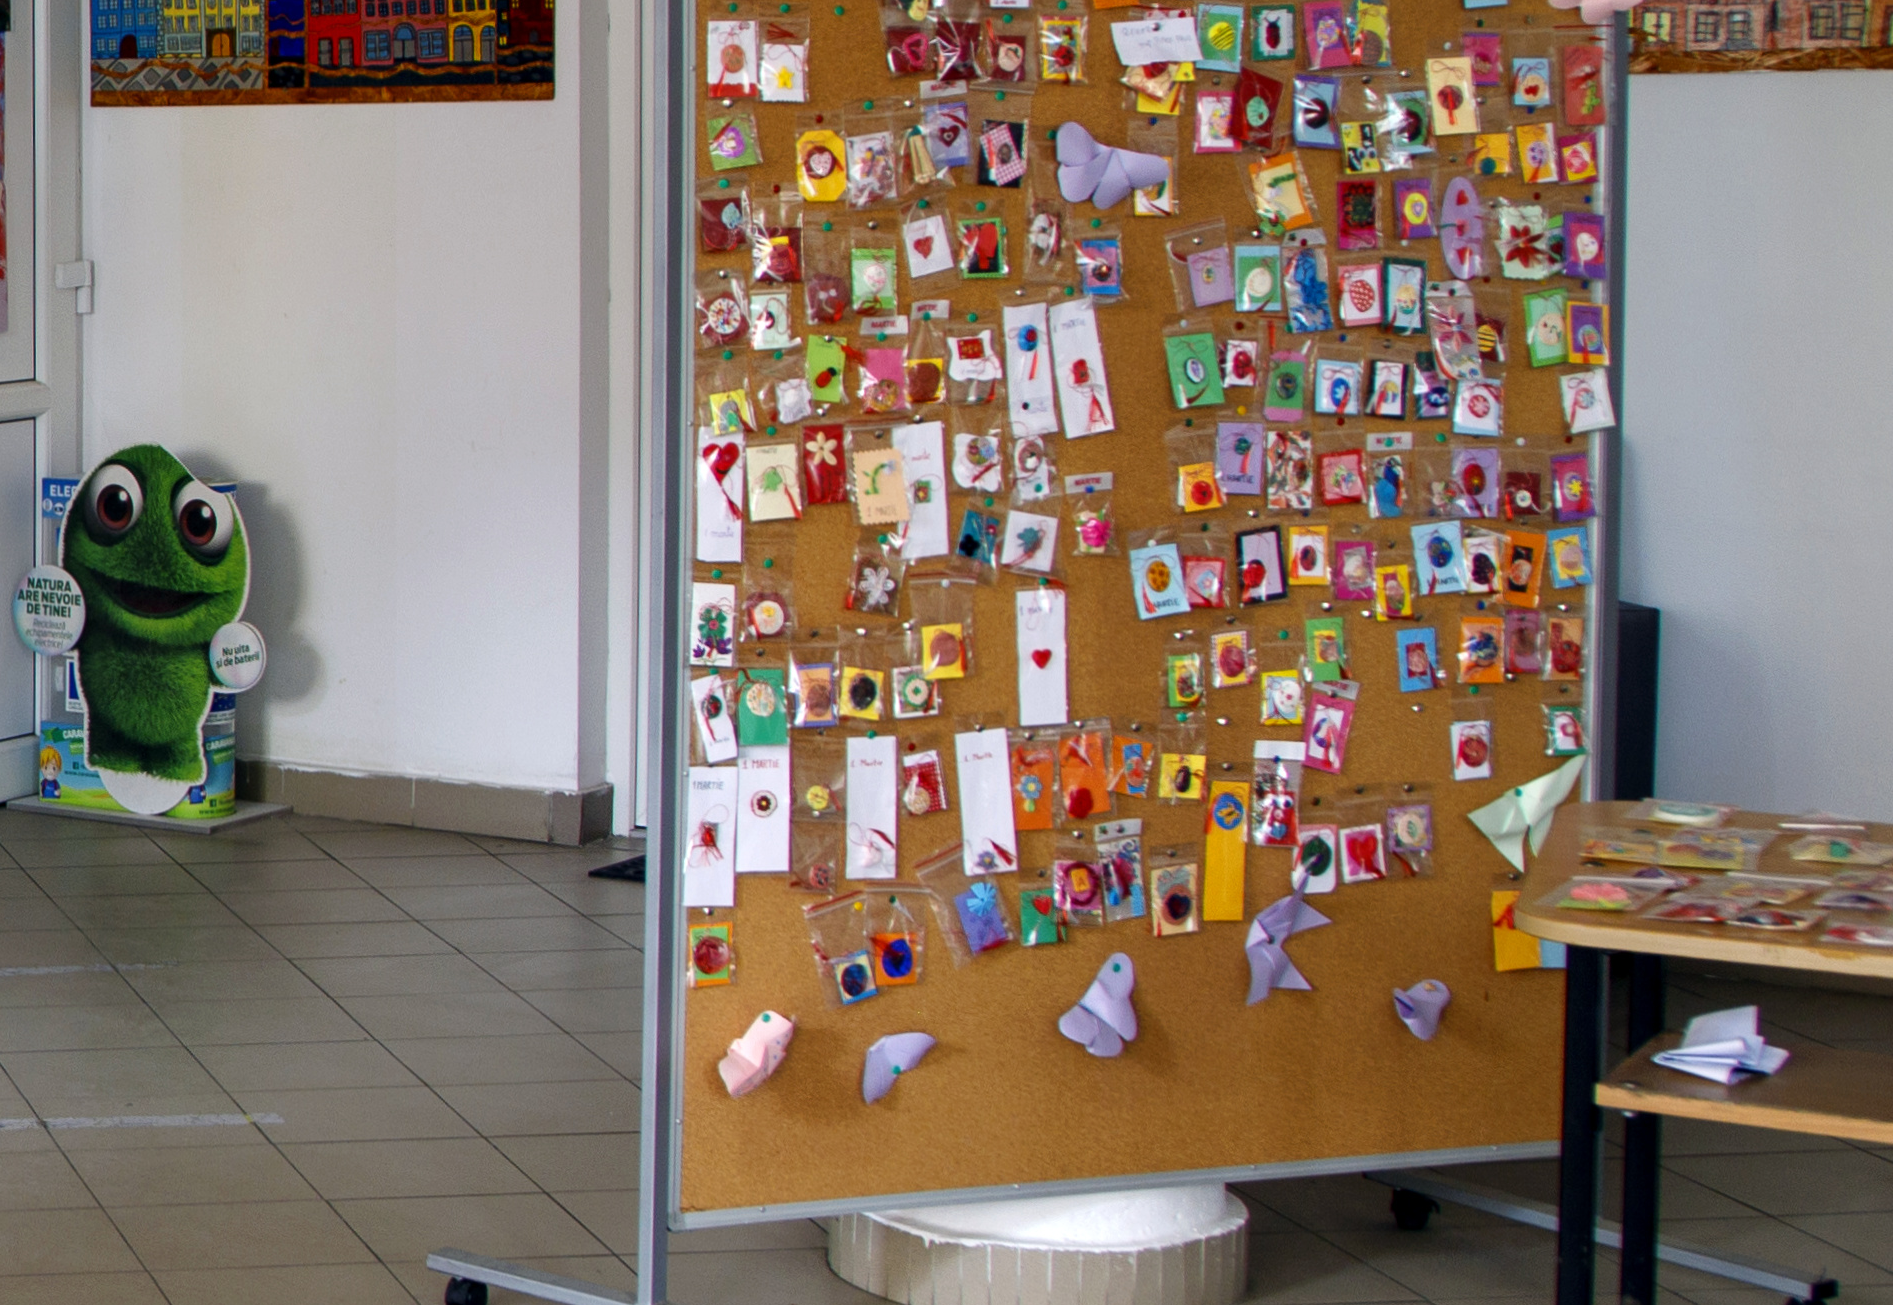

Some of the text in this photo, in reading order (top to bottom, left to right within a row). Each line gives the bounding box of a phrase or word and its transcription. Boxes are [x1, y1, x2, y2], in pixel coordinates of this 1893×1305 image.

[28, 577, 71, 592] NATURA
[18, 589, 81, 606] ARE NEVOIE
[27, 603, 71, 618] DE TINE!
[222, 647, 233, 656] Nu
[224, 657, 233, 666] de
